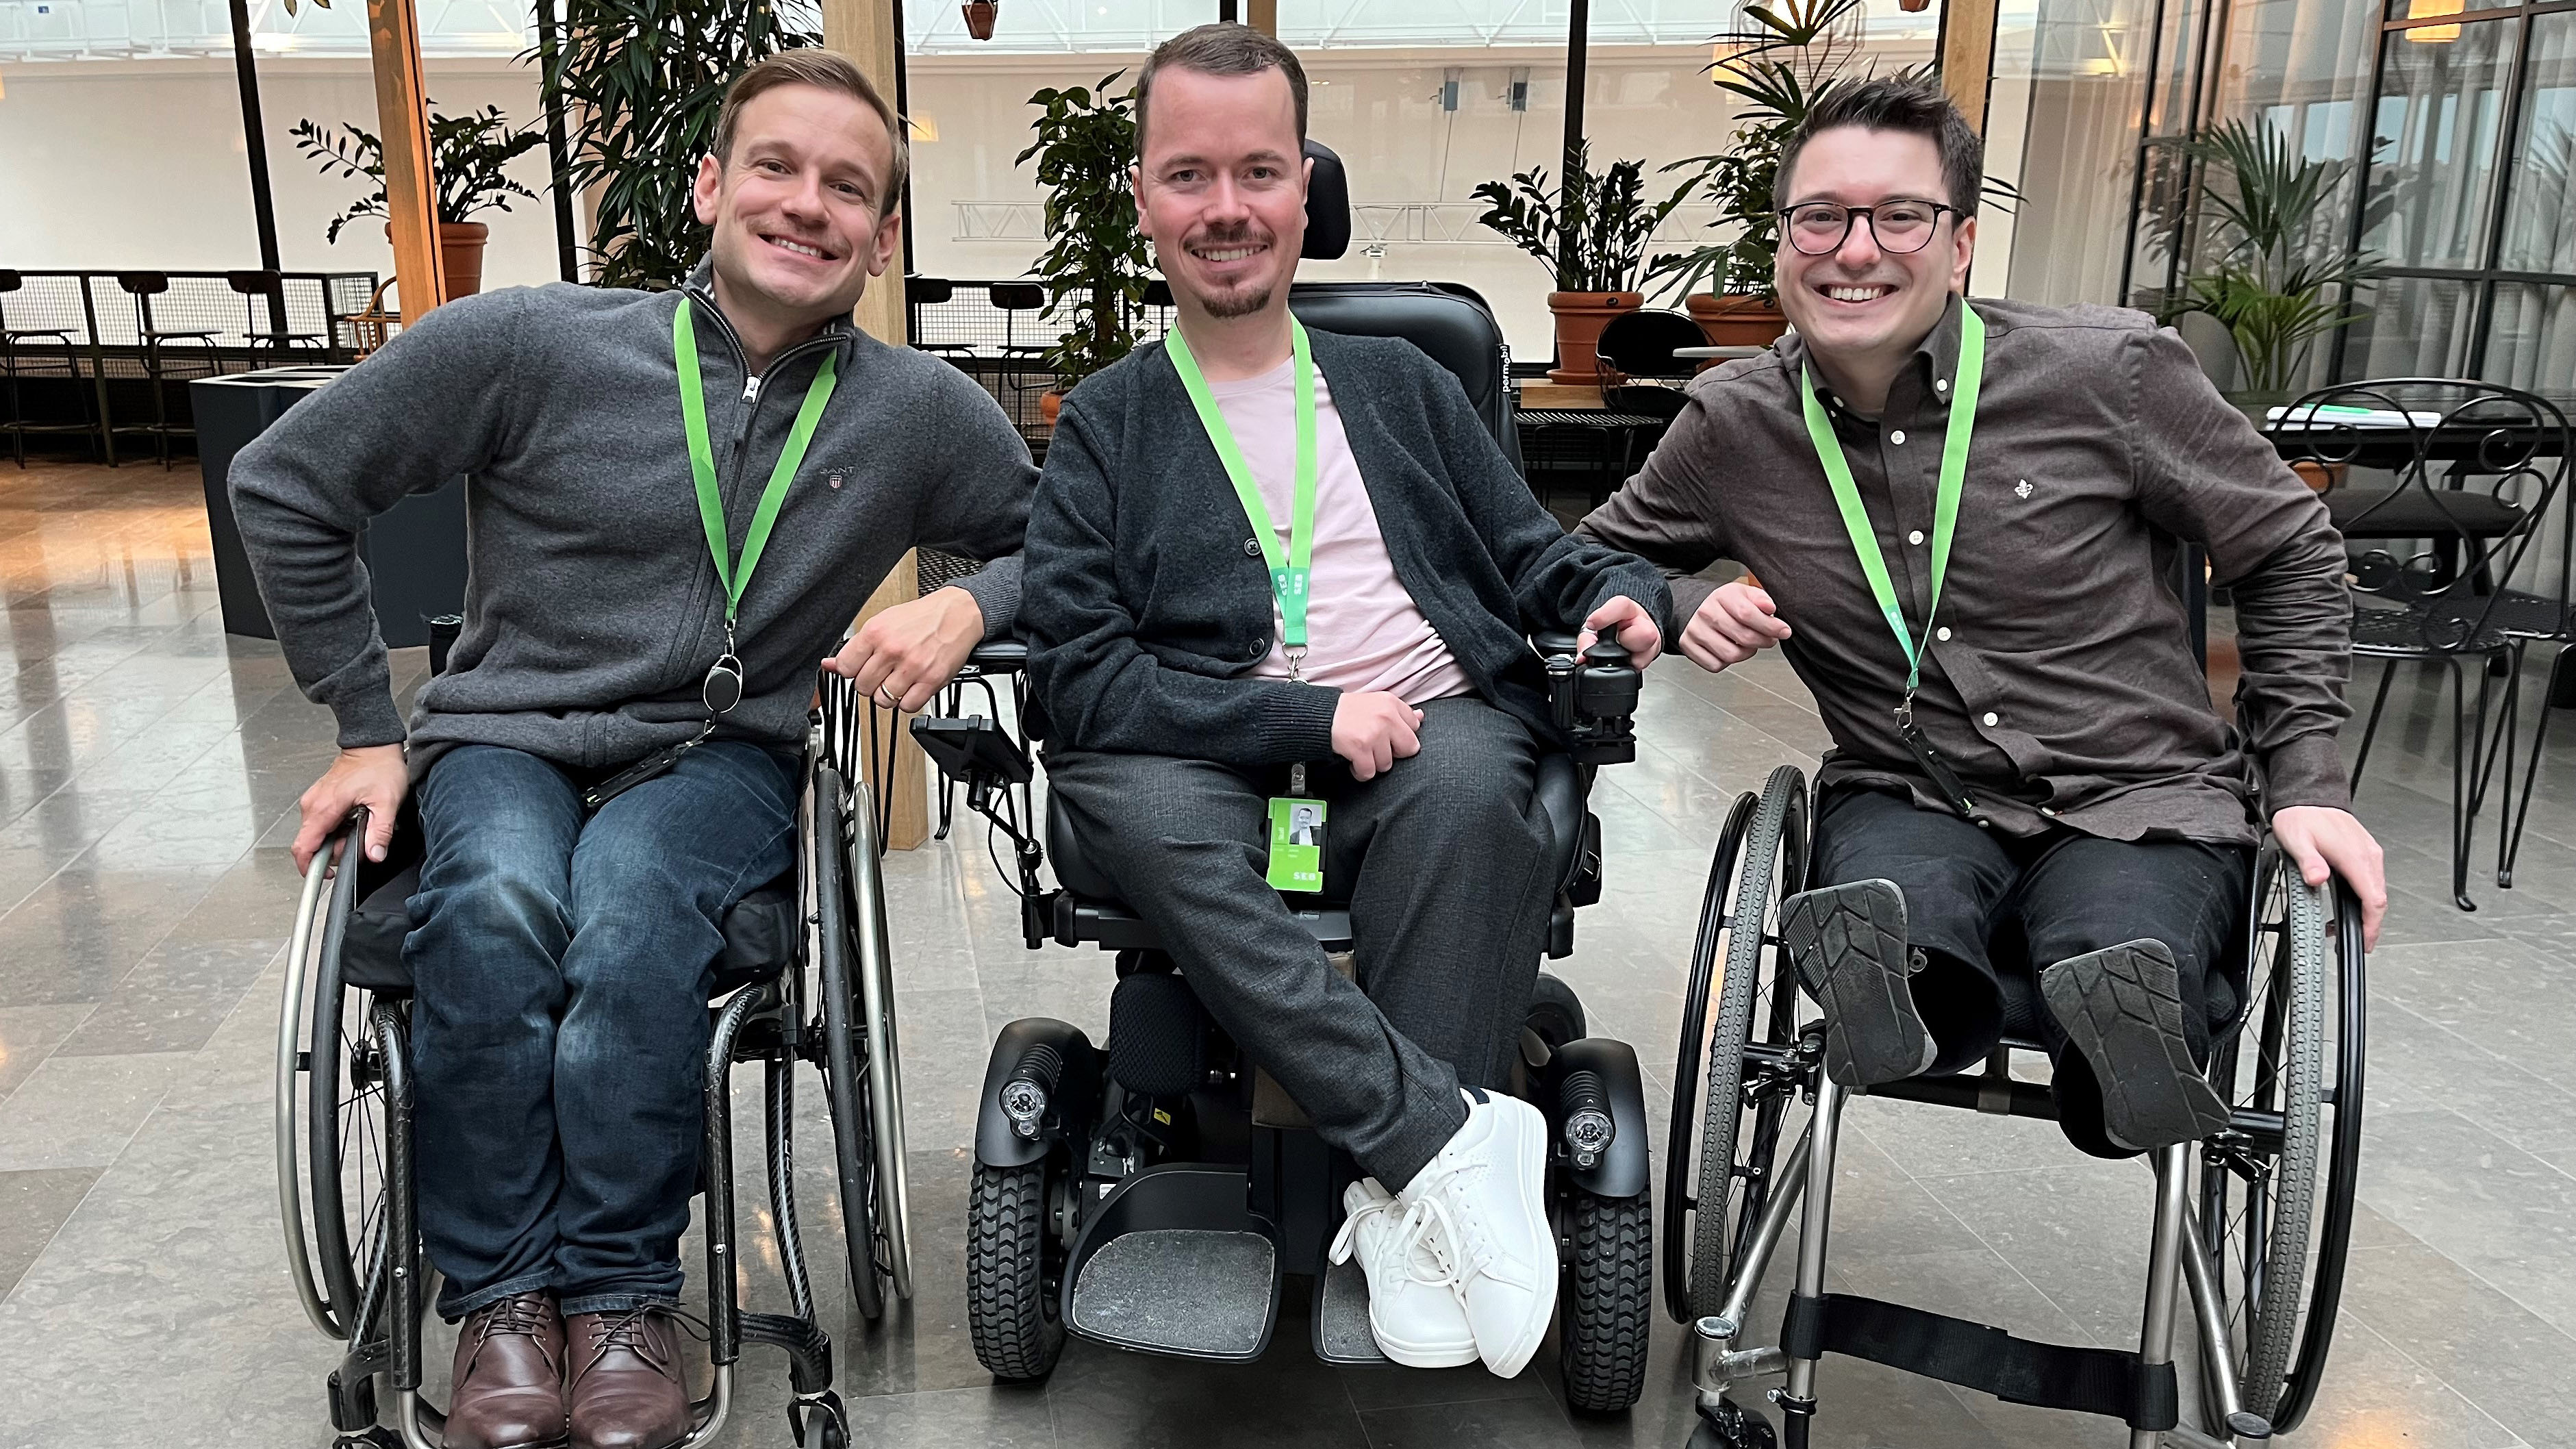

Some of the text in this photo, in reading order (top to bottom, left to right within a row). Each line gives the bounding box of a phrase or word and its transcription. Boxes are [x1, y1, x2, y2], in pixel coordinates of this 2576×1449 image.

[1500, 345, 1511, 392] permobil
[1294, 574, 1302, 595] SEB
[1293, 871, 1316, 881] SEB
